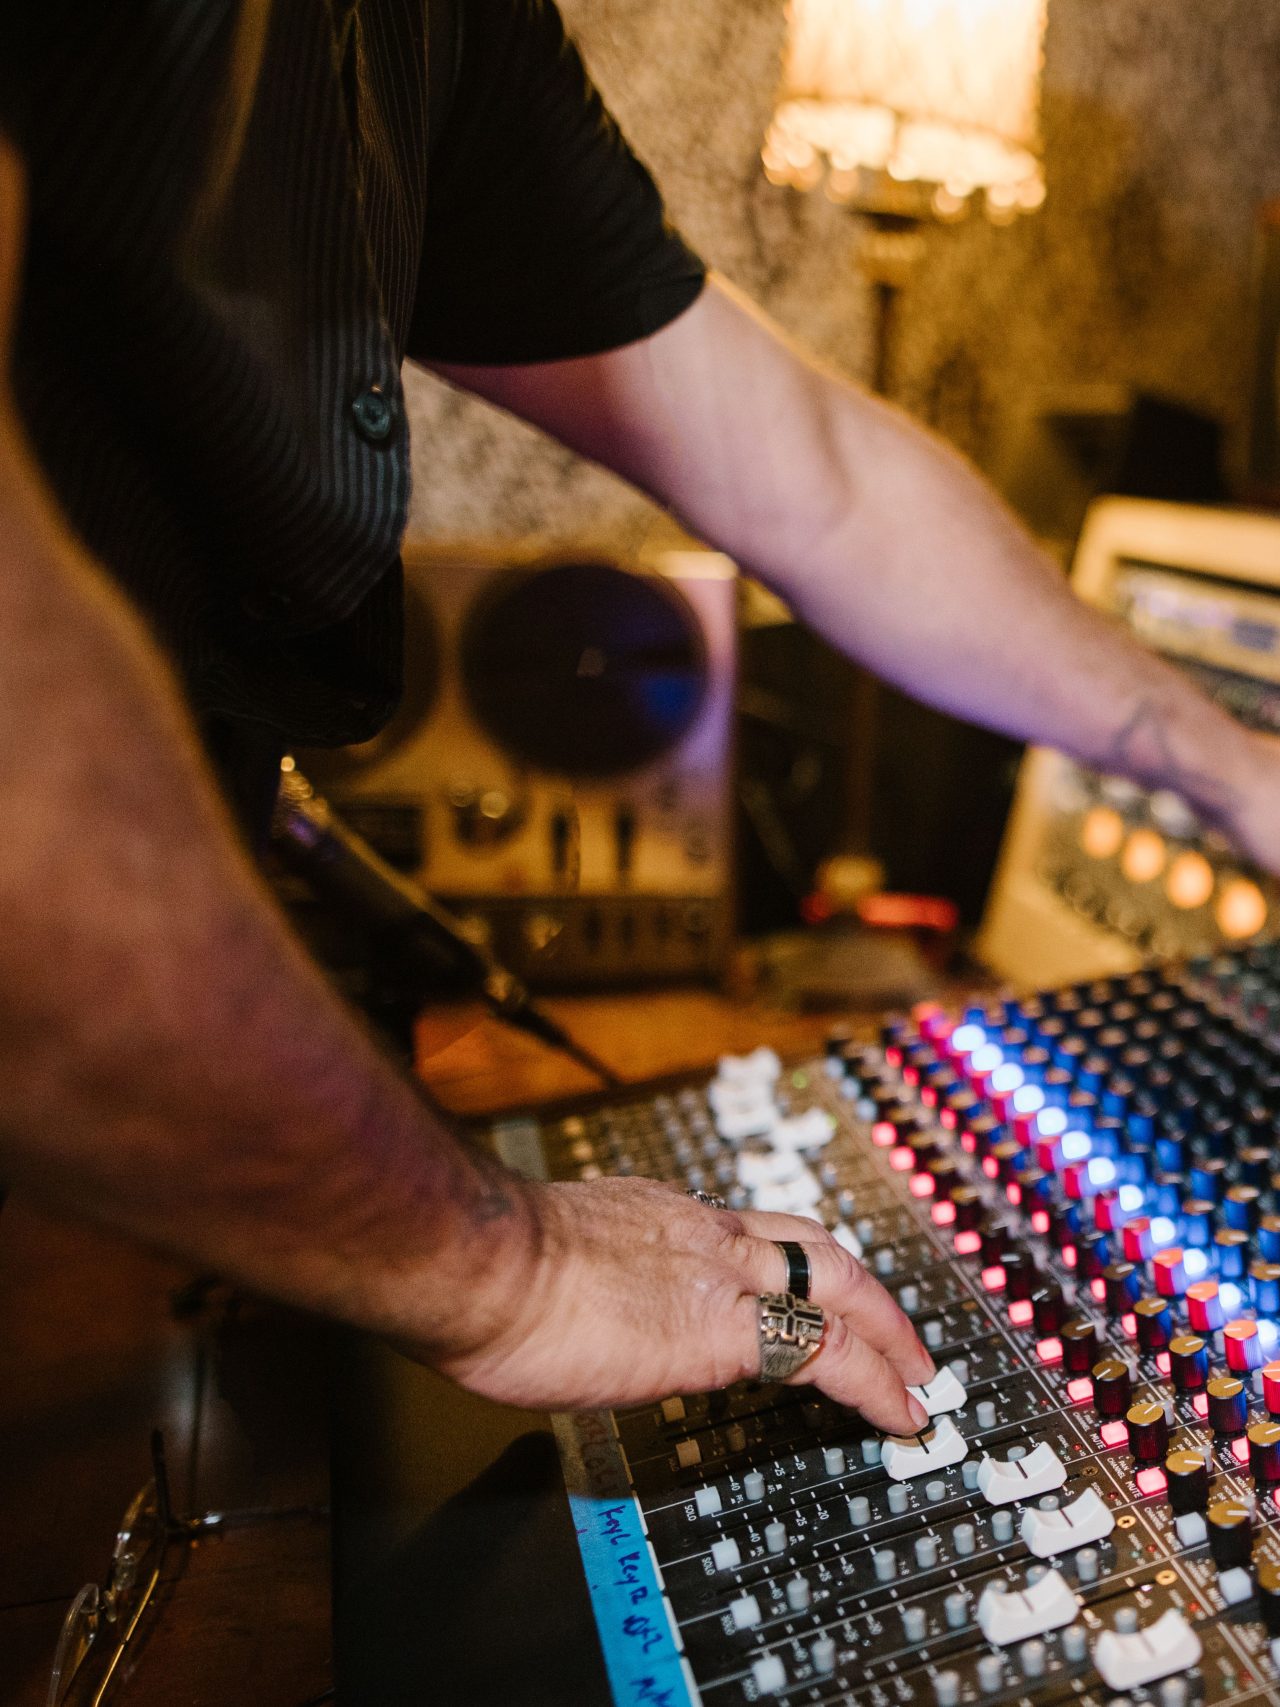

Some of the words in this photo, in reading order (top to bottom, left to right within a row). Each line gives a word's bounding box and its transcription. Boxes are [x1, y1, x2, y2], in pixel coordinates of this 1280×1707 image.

[1089, 1432, 1108, 1450] MUTE
[1194, 1428, 1205, 1440] MON
[1057, 1434, 1070, 1450] SIGNAL
[1217, 1451, 1231, 1466] MUTE
[1221, 1446, 1241, 1468] MONITOR
[774, 1466, 787, 1477] 25
[795, 1460, 807, 1471] 20
[1107, 1456, 1126, 1479] CHANNEL
[1118, 1460, 1131, 1471] PAN
[730, 1481, 741, 1492] 40
[1233, 1475, 1246, 1489] MON
[1125, 1480, 1144, 1500] MUTE
[684, 1504, 697, 1522] SOLO
[817, 1509, 830, 1521] 20
[1144, 1505, 1165, 1532] CHANNEL
[795, 1516, 808, 1527] 25
[750, 1532, 761, 1543] 40
[701, 1555, 716, 1576] SOLO
